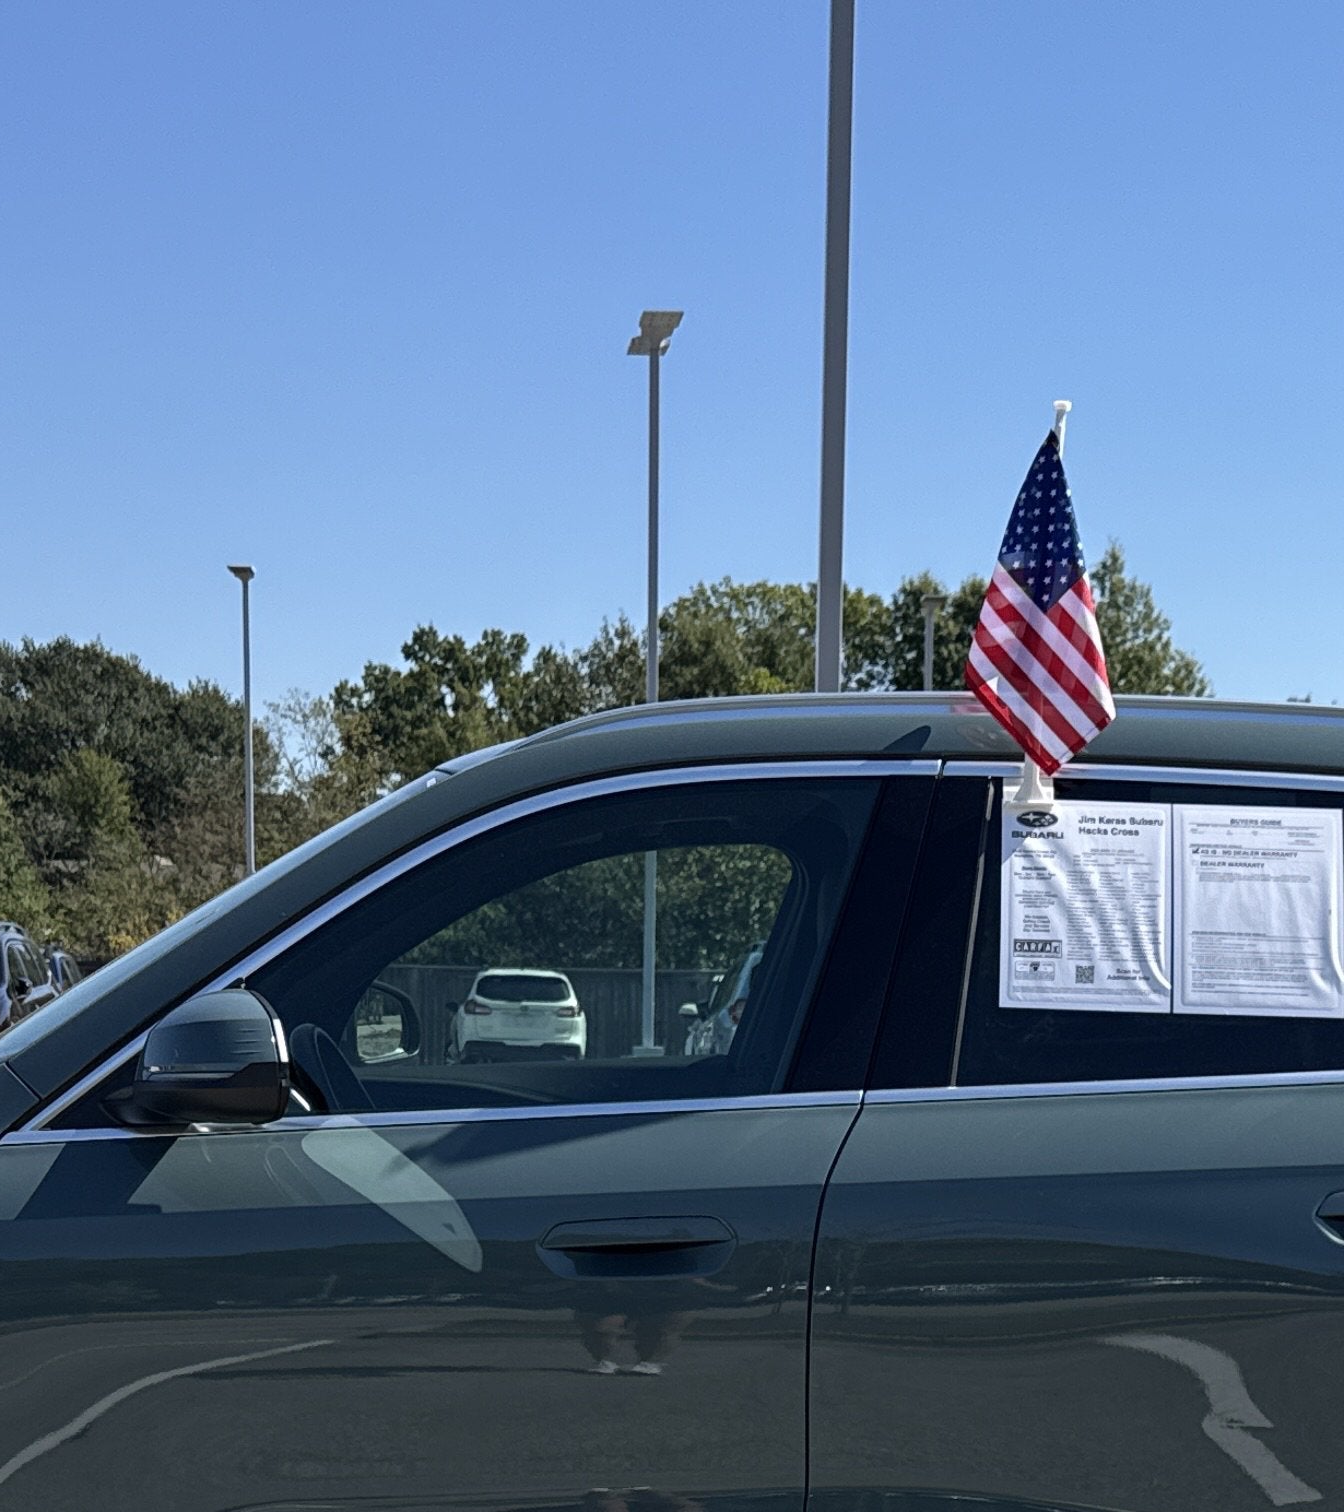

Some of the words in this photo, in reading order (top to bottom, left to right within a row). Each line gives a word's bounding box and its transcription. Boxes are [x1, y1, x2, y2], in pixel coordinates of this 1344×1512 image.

[1078, 815, 1096, 825] Jim
[1098, 816, 1126, 825] Keras
[1129, 817, 1164, 827] Subaru
[1011, 830, 1064, 839] SUBARU
[1111, 827, 1139, 836] Cross
[1015, 942, 1060, 953] CARFAX
